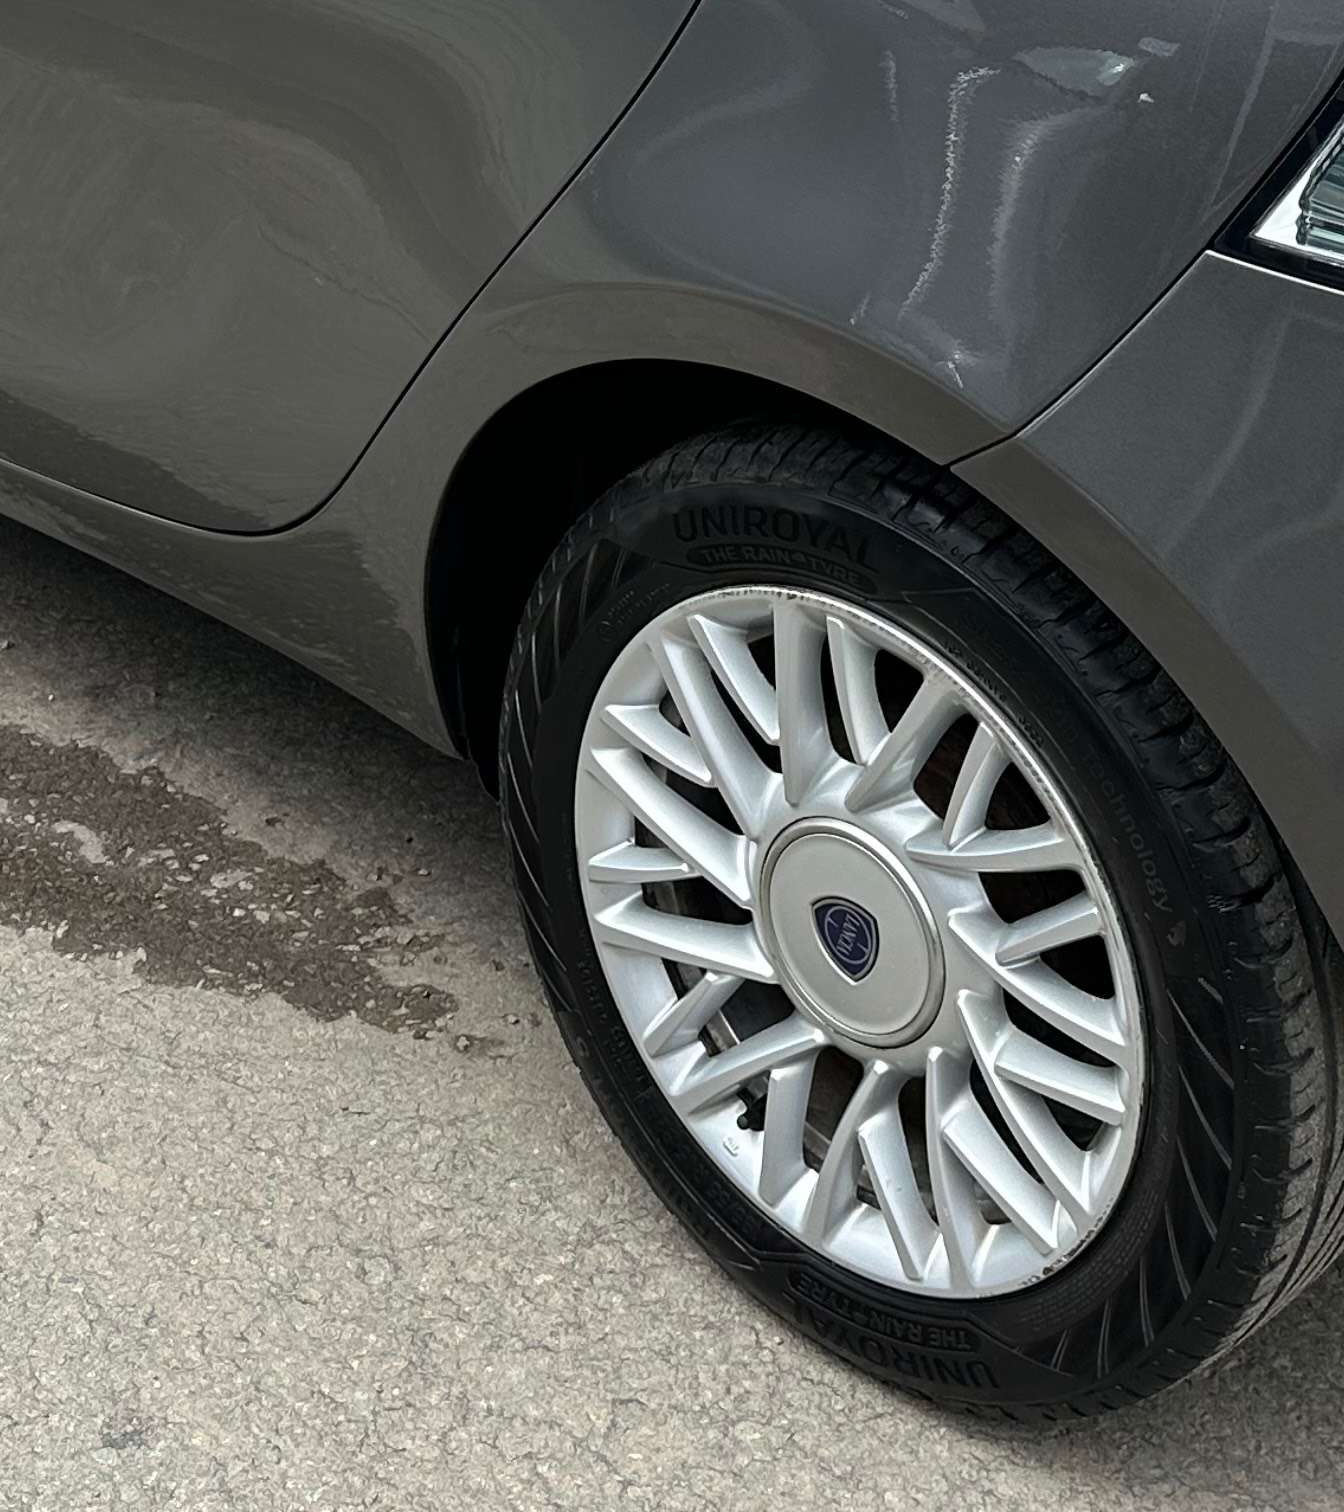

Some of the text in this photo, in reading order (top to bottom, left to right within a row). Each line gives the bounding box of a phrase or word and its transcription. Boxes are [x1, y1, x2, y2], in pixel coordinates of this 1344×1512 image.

[672, 504, 879, 573] UNIROYAL
[702, 545, 858, 585] THE RAIN TYRE
